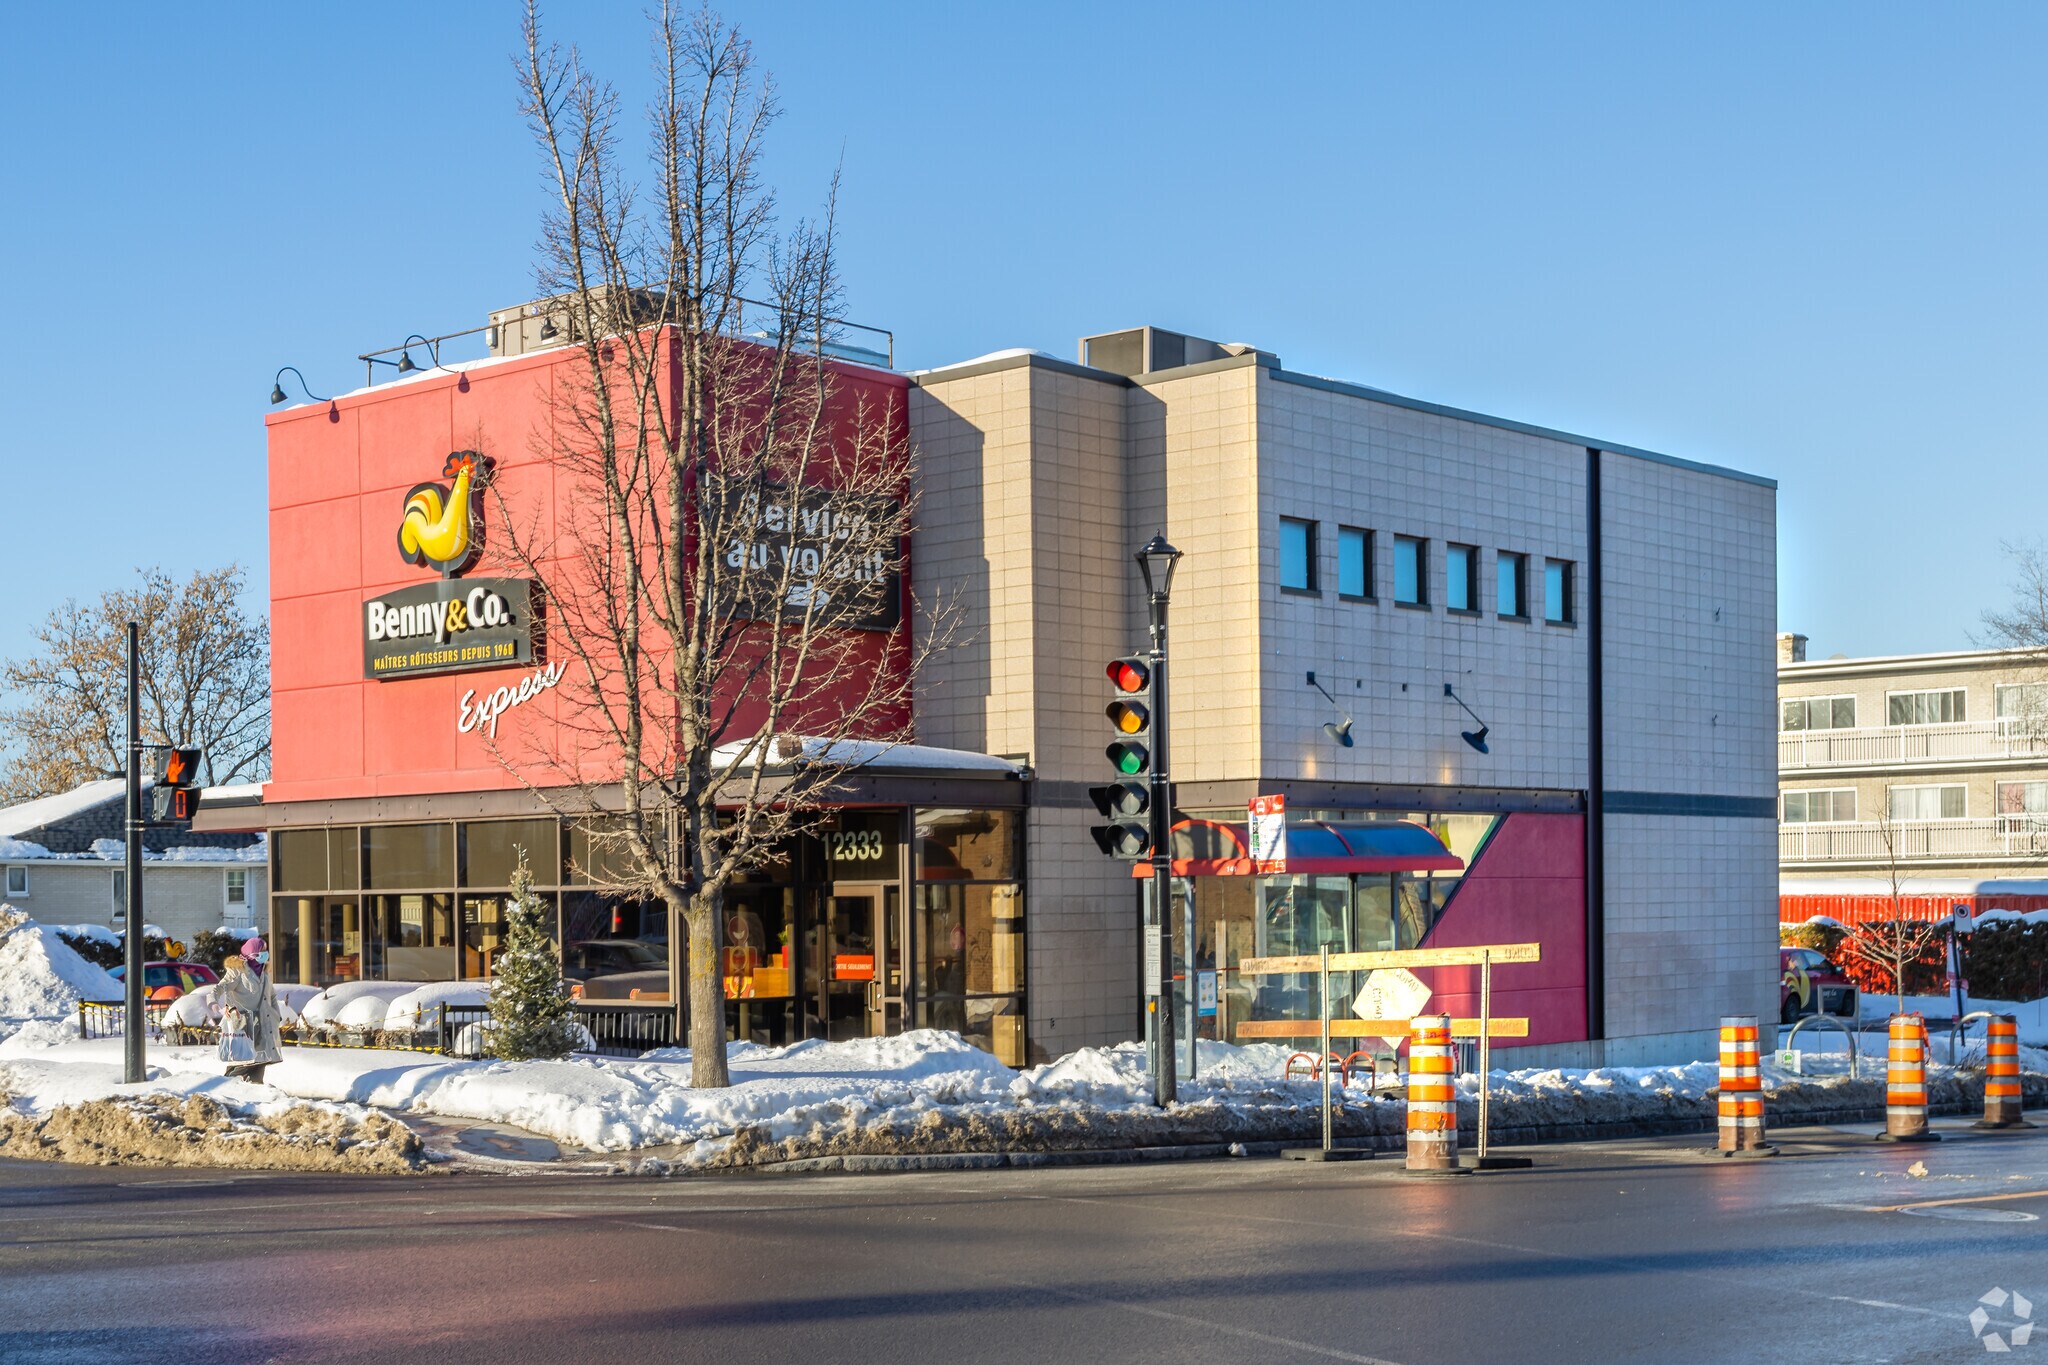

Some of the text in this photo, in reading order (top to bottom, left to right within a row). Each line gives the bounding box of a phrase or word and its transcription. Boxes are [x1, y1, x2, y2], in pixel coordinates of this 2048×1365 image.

[727, 538, 767, 570] au
[367, 586, 509, 643] Benny&Co.
[374, 642, 514, 671] MAÎTRES RÔTISSEURS DEPUIS 1960
[457, 658, 567, 739] Express
[821, 830, 883, 861] 12333
